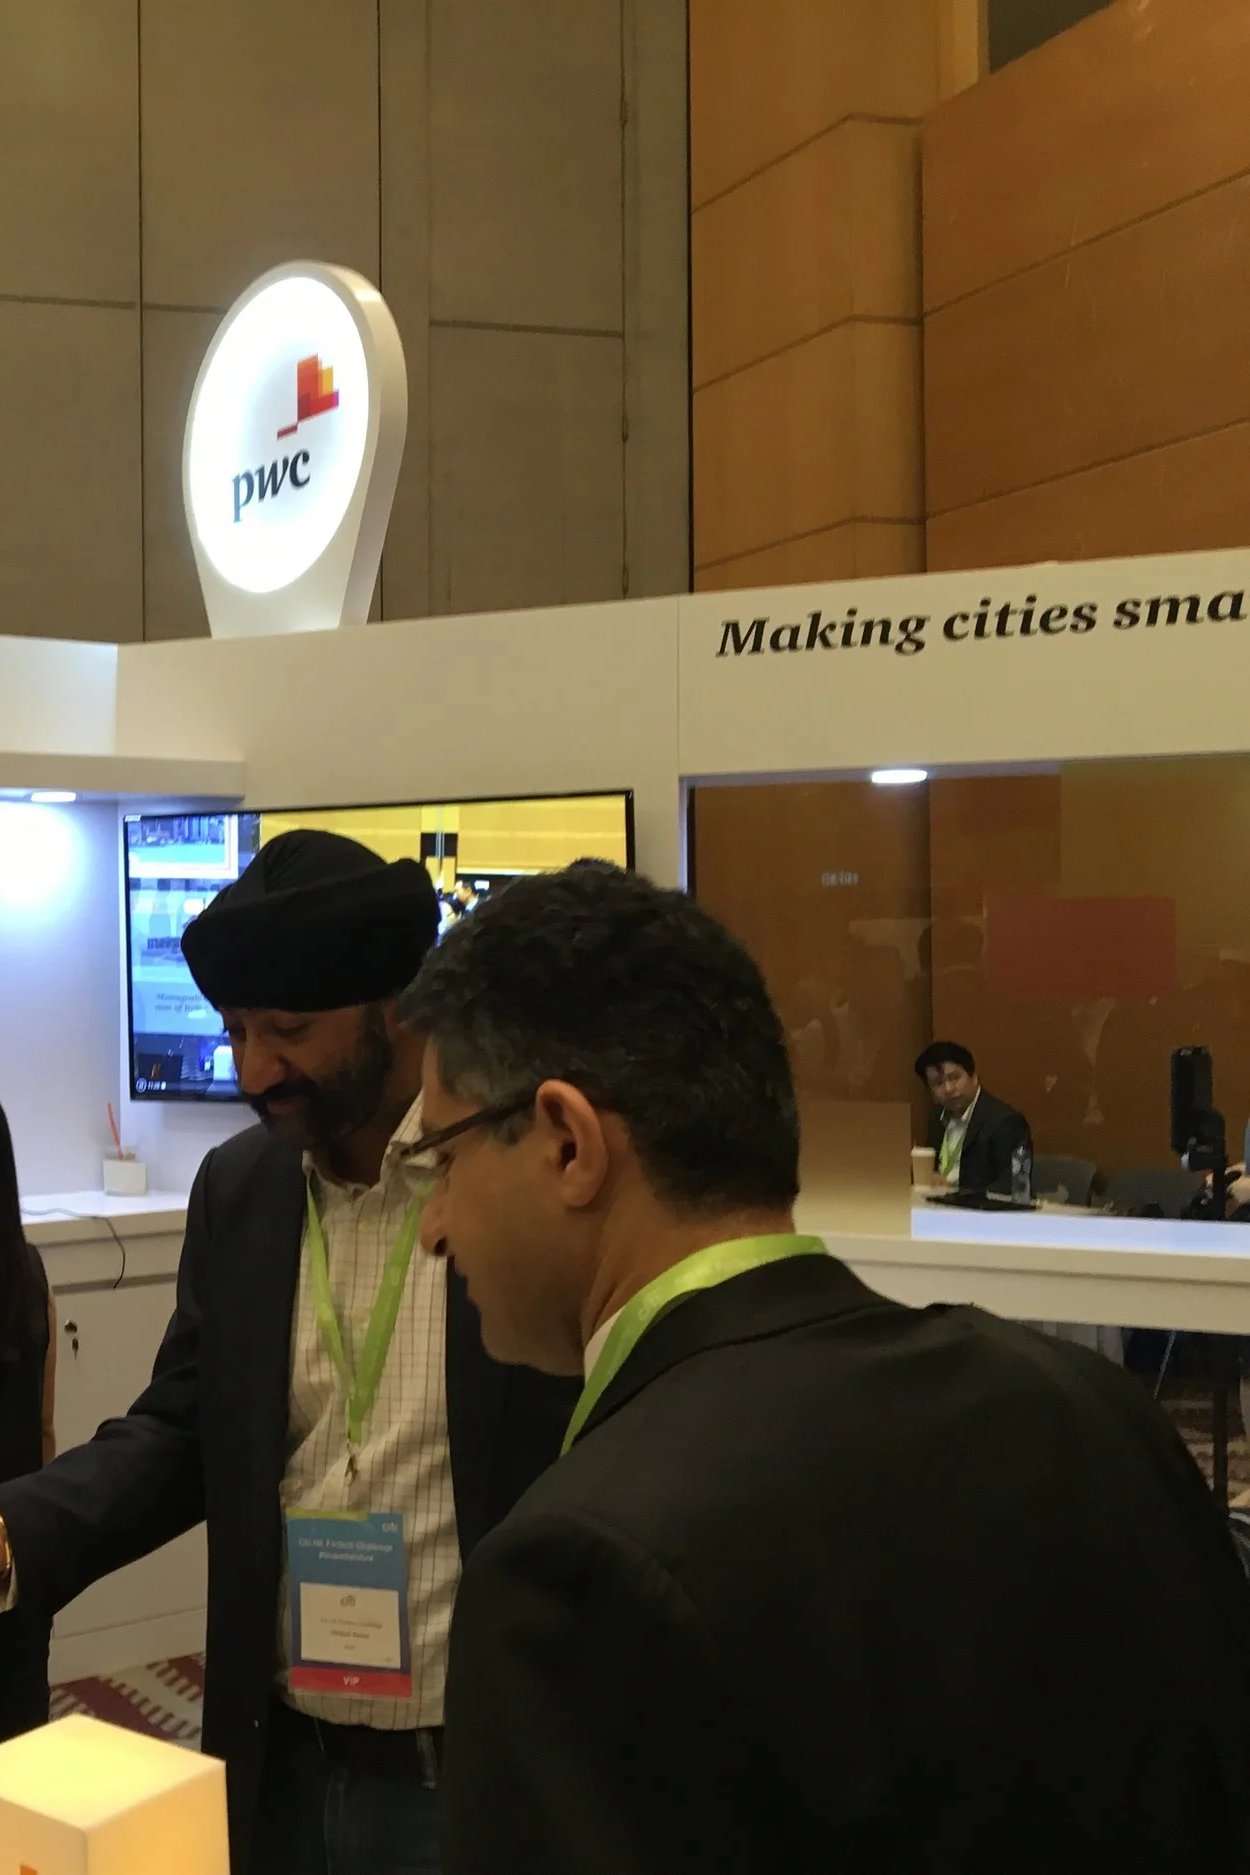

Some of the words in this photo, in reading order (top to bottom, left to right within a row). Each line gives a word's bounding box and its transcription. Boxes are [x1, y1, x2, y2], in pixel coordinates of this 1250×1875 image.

[231, 448, 312, 523] pwc
[716, 607, 931, 657] Making
[942, 594, 1100, 642] cities
[1111, 588, 1250, 630] sma
[343, 1675, 360, 1687] VIP
